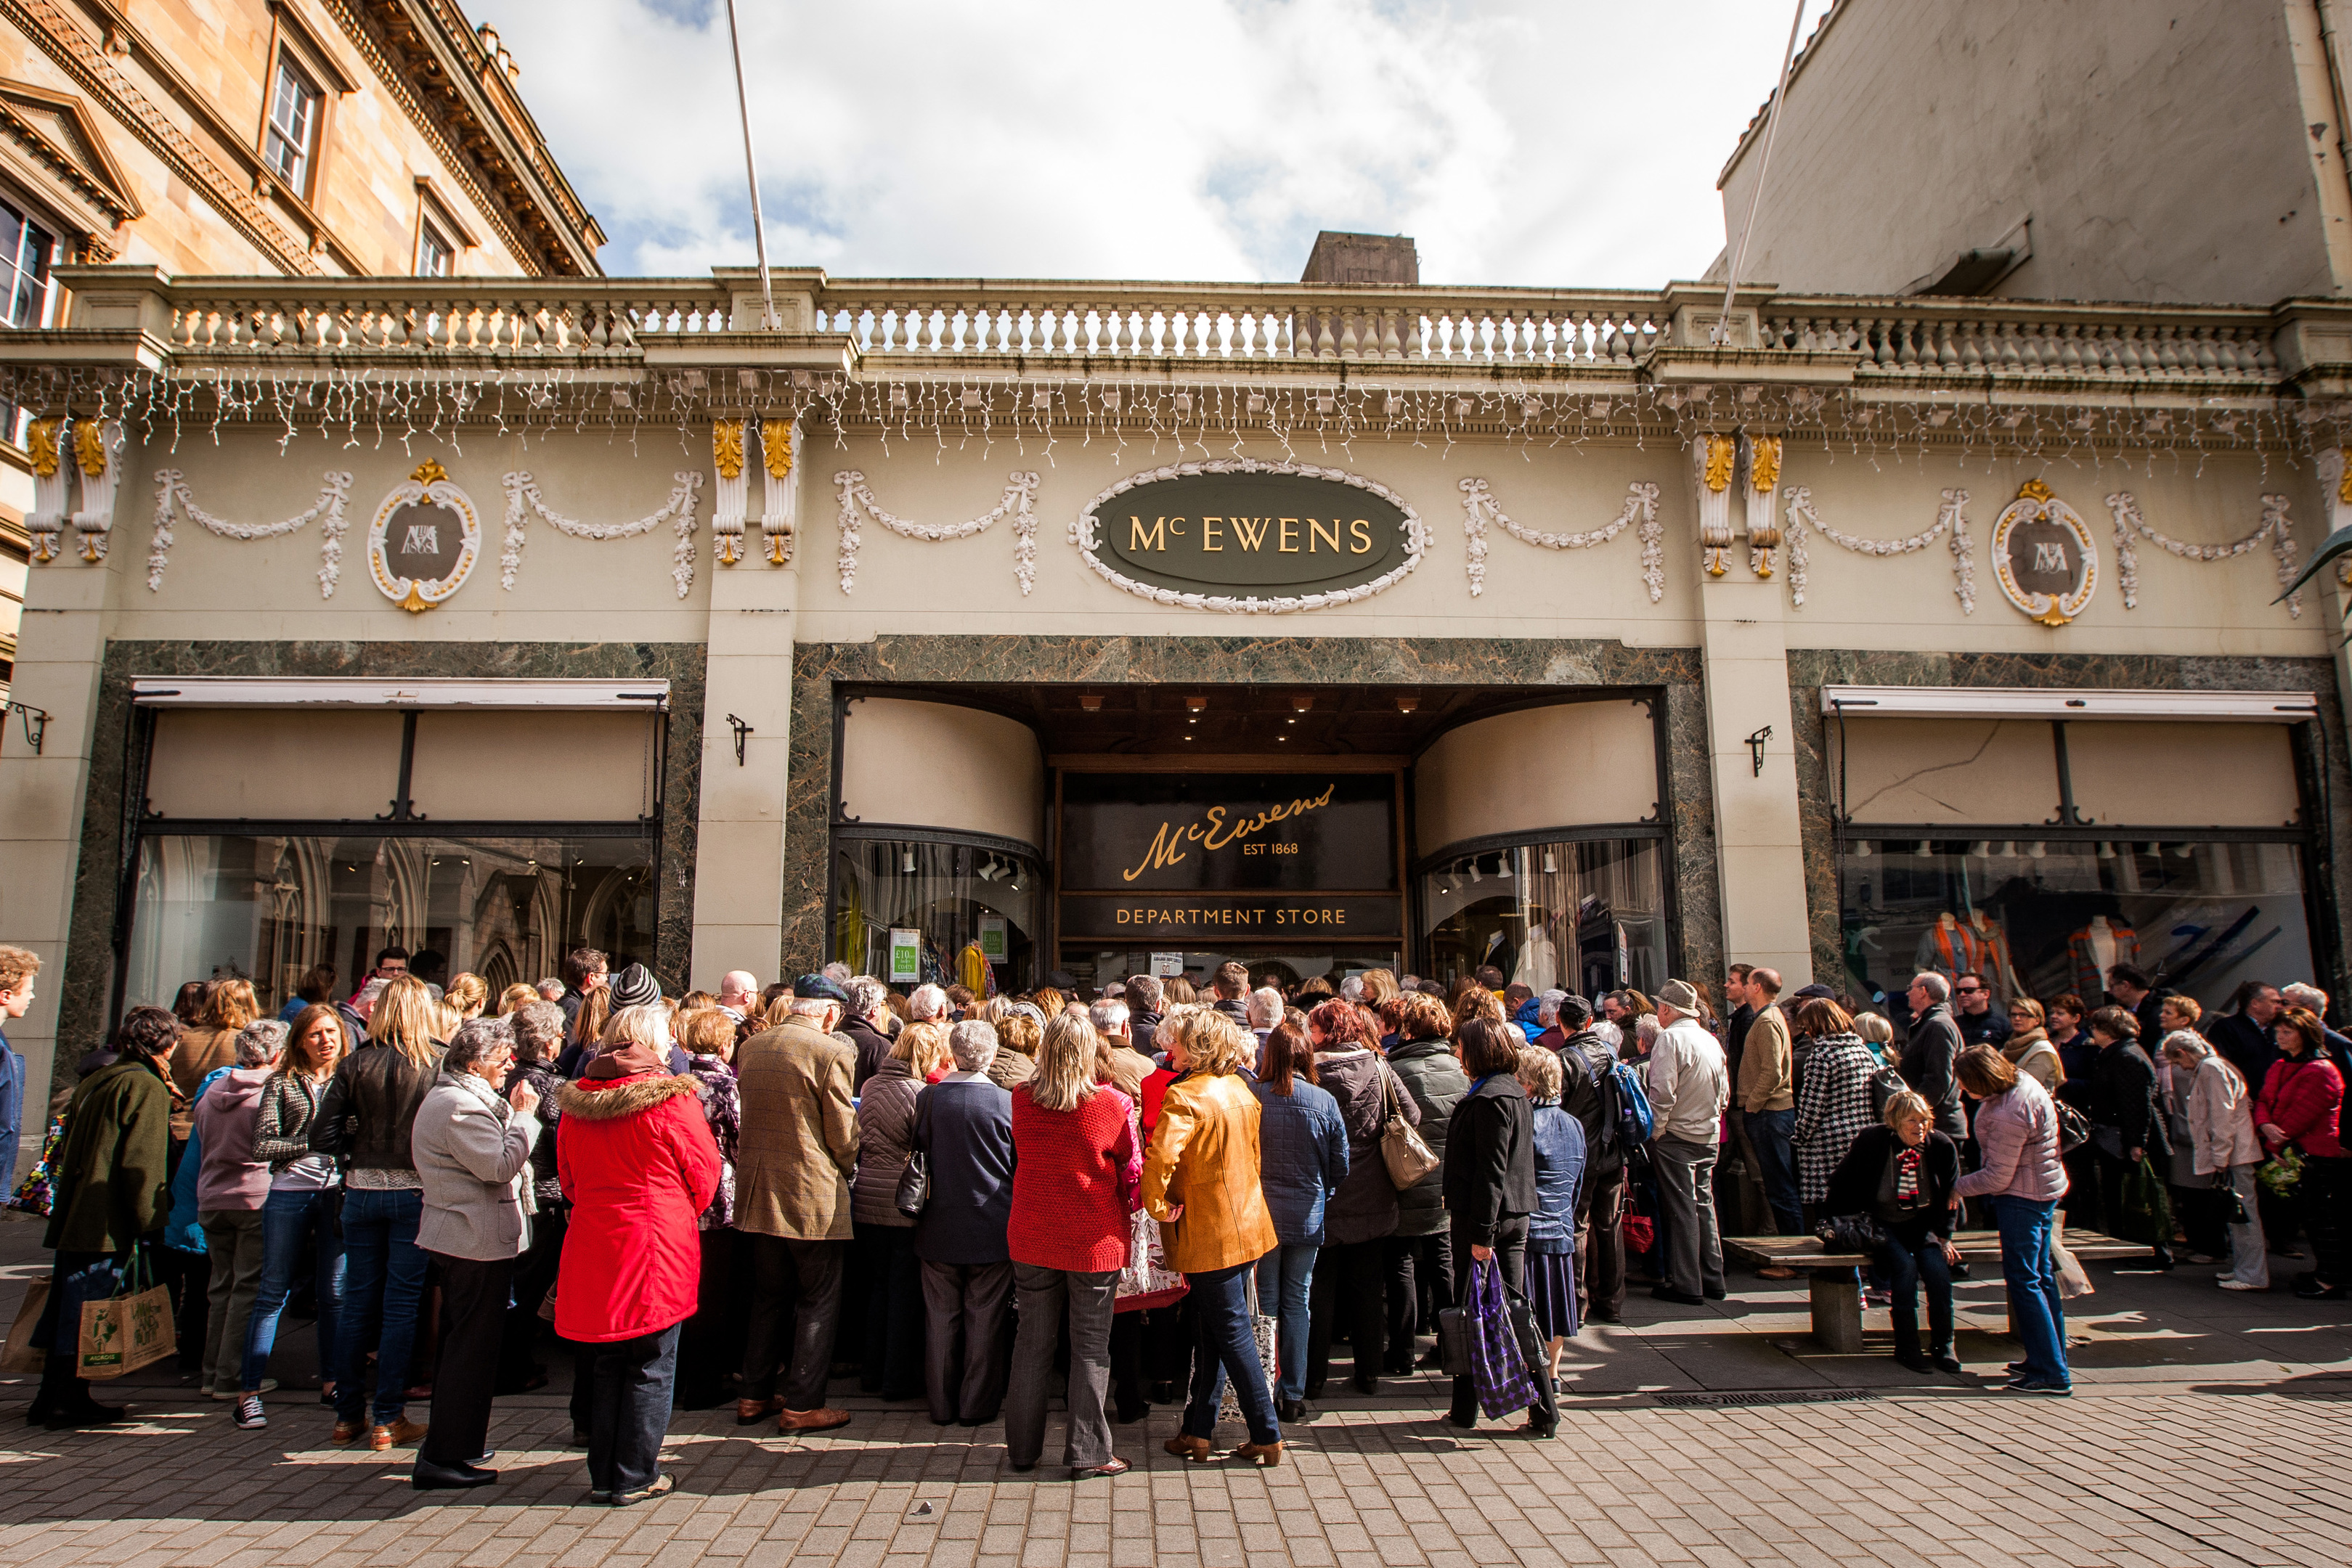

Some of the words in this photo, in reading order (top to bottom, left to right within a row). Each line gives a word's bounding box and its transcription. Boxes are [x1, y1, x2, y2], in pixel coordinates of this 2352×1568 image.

[1203, 516, 1372, 554] EWENS
[1123, 783, 1335, 881] McEwens
[1244, 844, 1266, 855] EST
[1272, 844, 1298, 854] 1868
[1117, 909, 1266, 924] DEPARTMENT
[1276, 909, 1346, 924] STORE
[895, 950, 909, 959] £10
